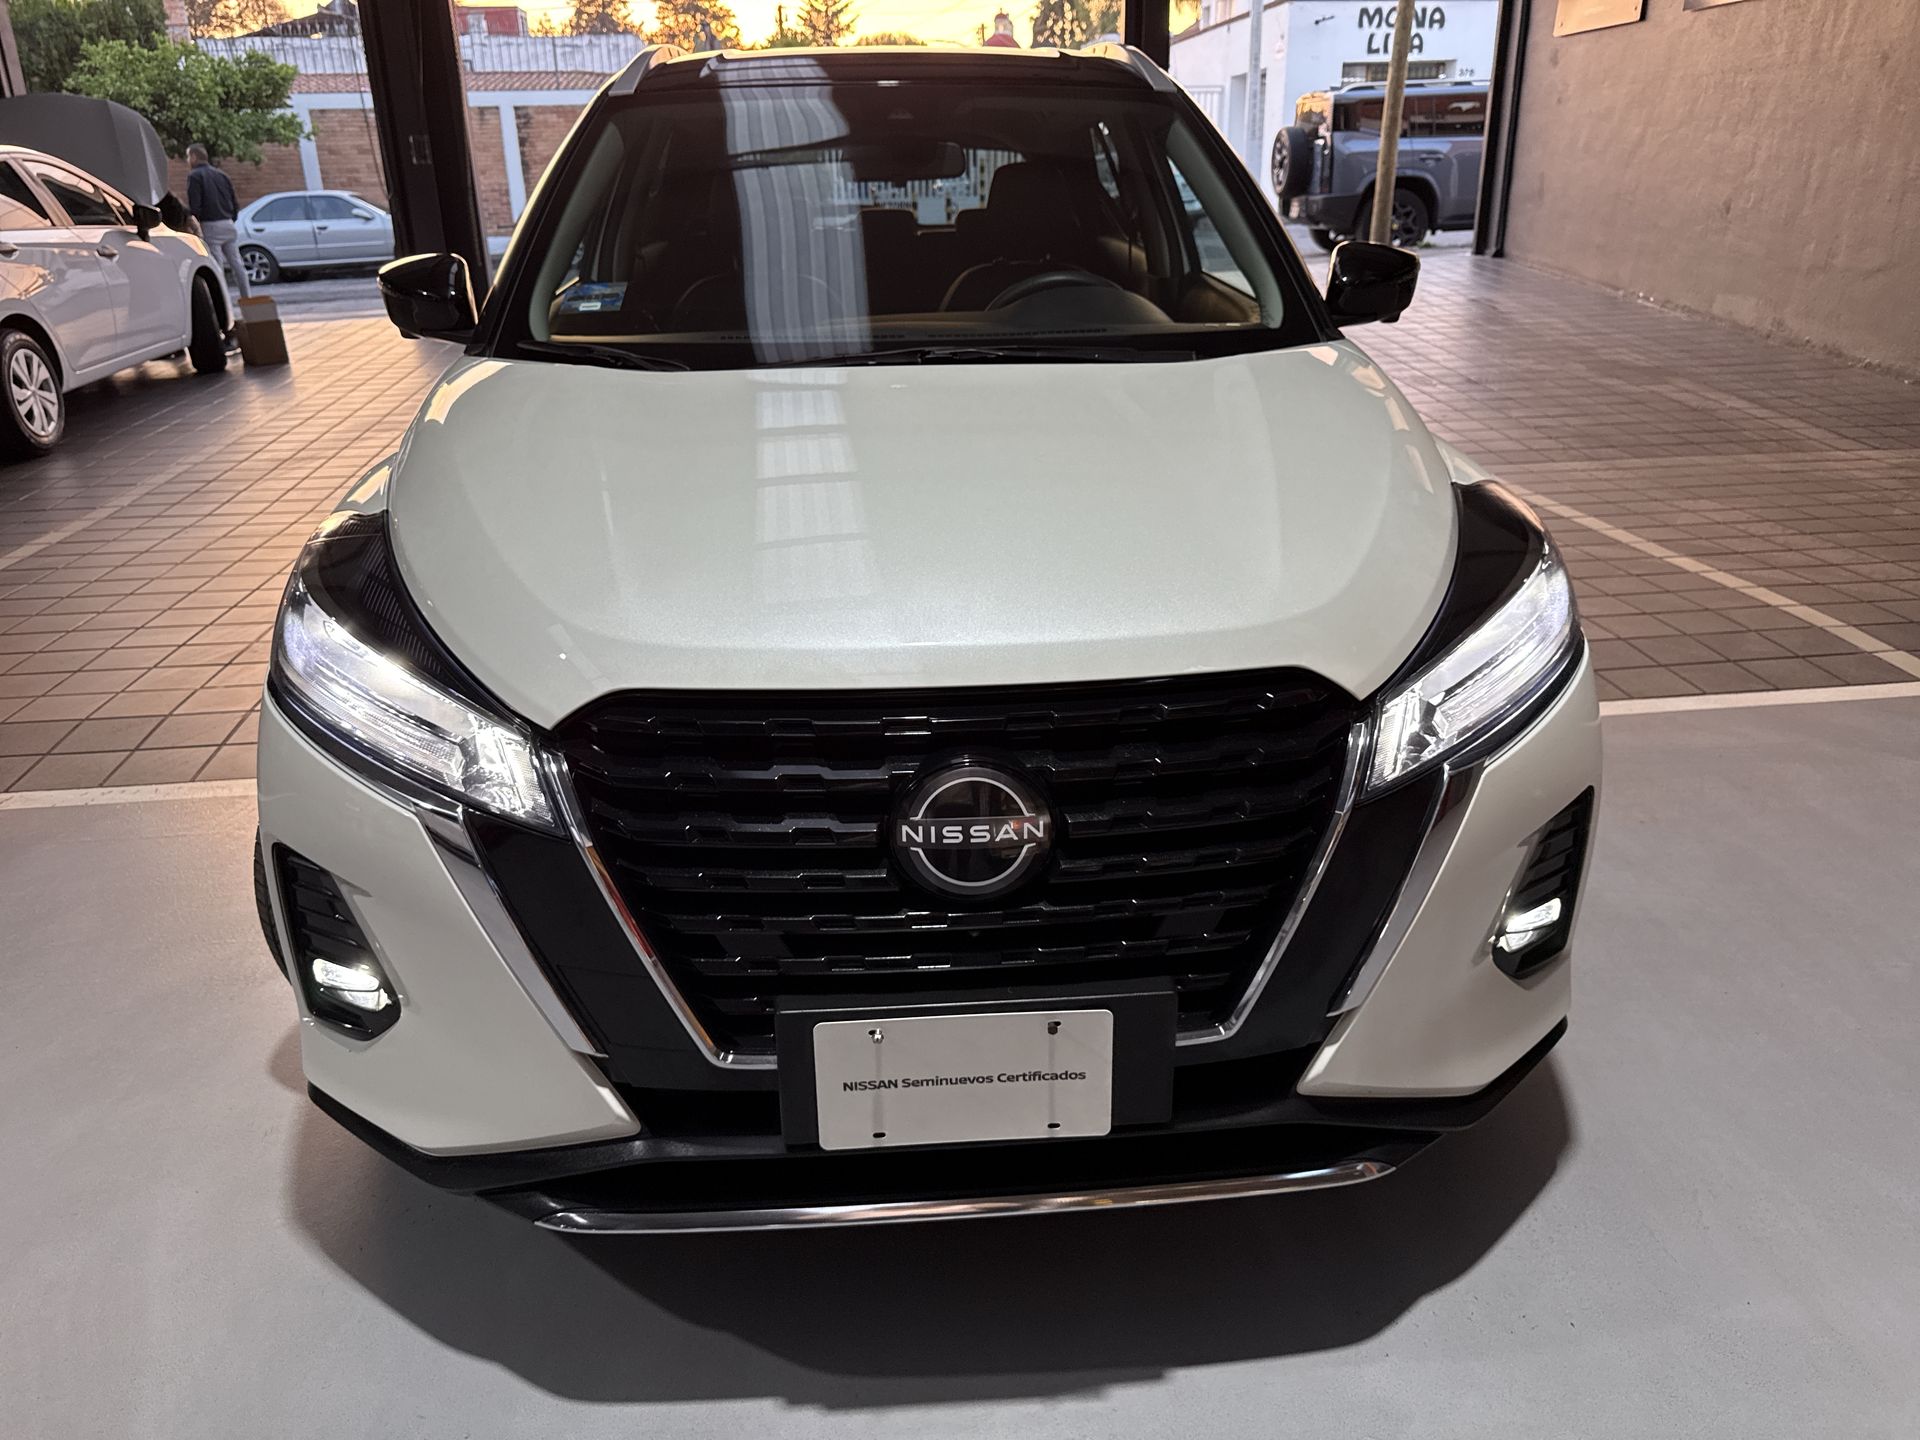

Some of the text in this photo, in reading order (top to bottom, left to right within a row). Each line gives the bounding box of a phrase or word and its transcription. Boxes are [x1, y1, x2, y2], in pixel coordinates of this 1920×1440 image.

[1366, 32, 1424, 55] LIA
[901, 820, 1045, 844] NISSAN
[842, 1070, 1087, 1092] NISSAN Seminuevos Certificados
